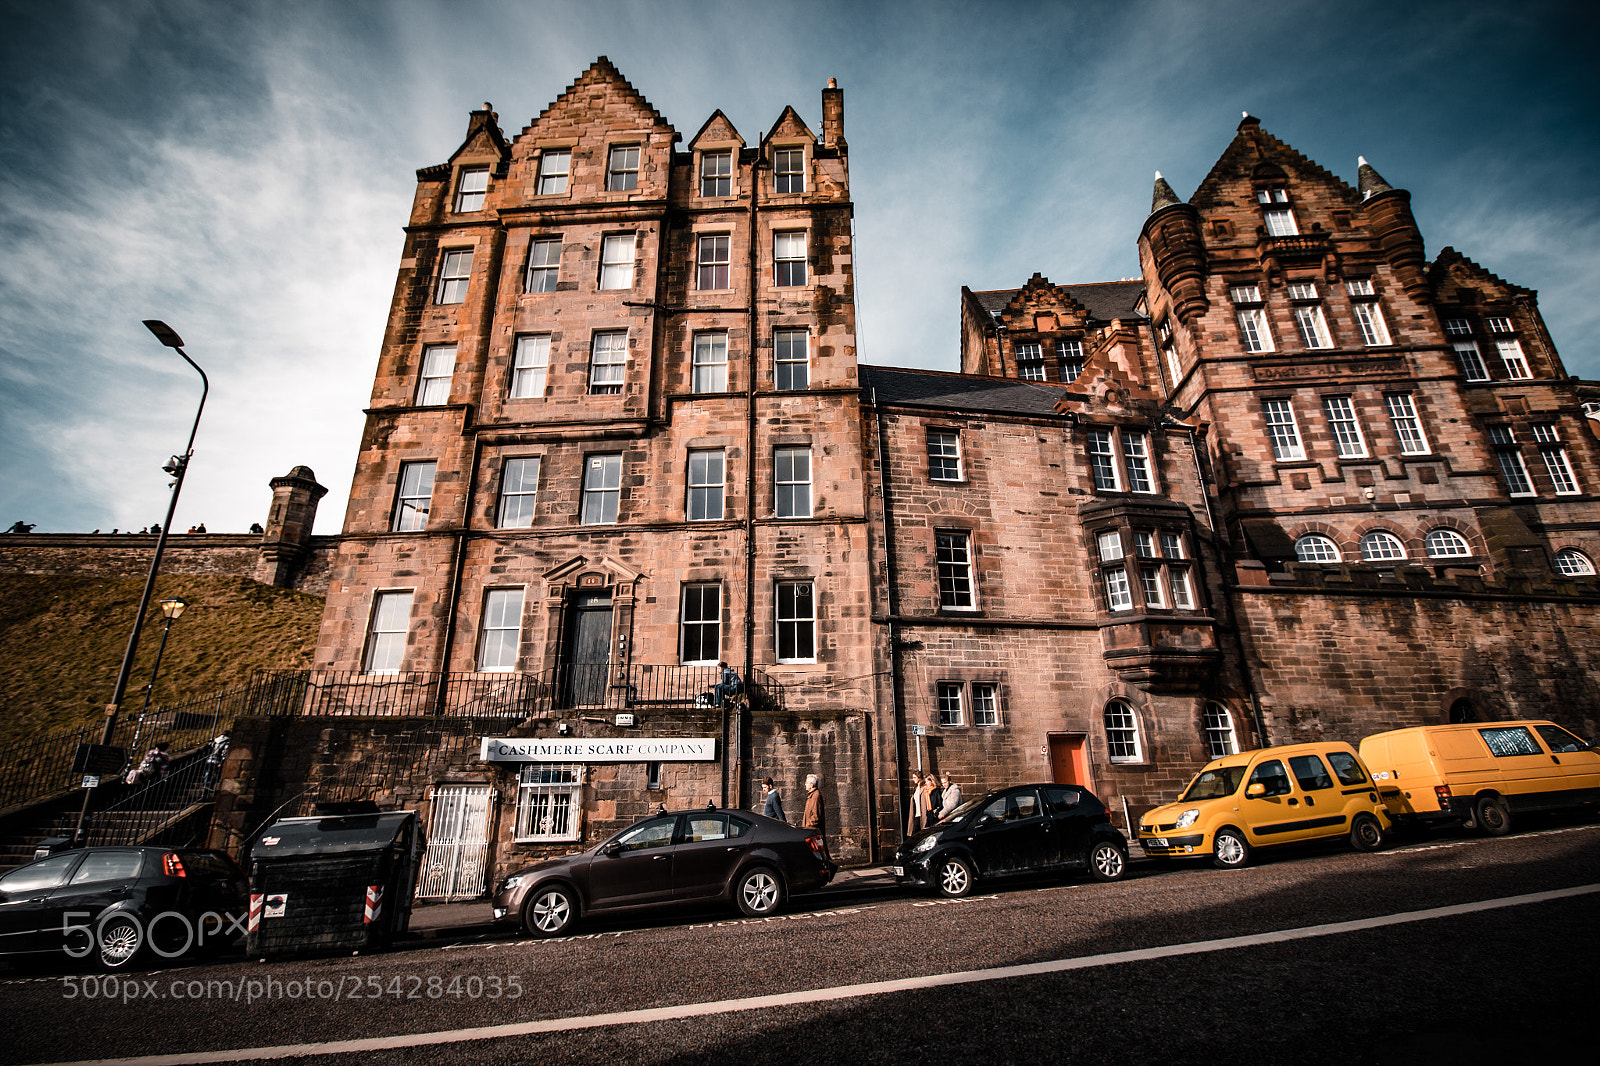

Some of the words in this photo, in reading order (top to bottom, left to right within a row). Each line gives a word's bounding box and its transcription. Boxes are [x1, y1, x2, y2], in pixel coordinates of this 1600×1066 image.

[498, 744, 583, 756] CASHMERE
[588, 744, 634, 756] SCARF
[638, 744, 706, 755] COMPANY
